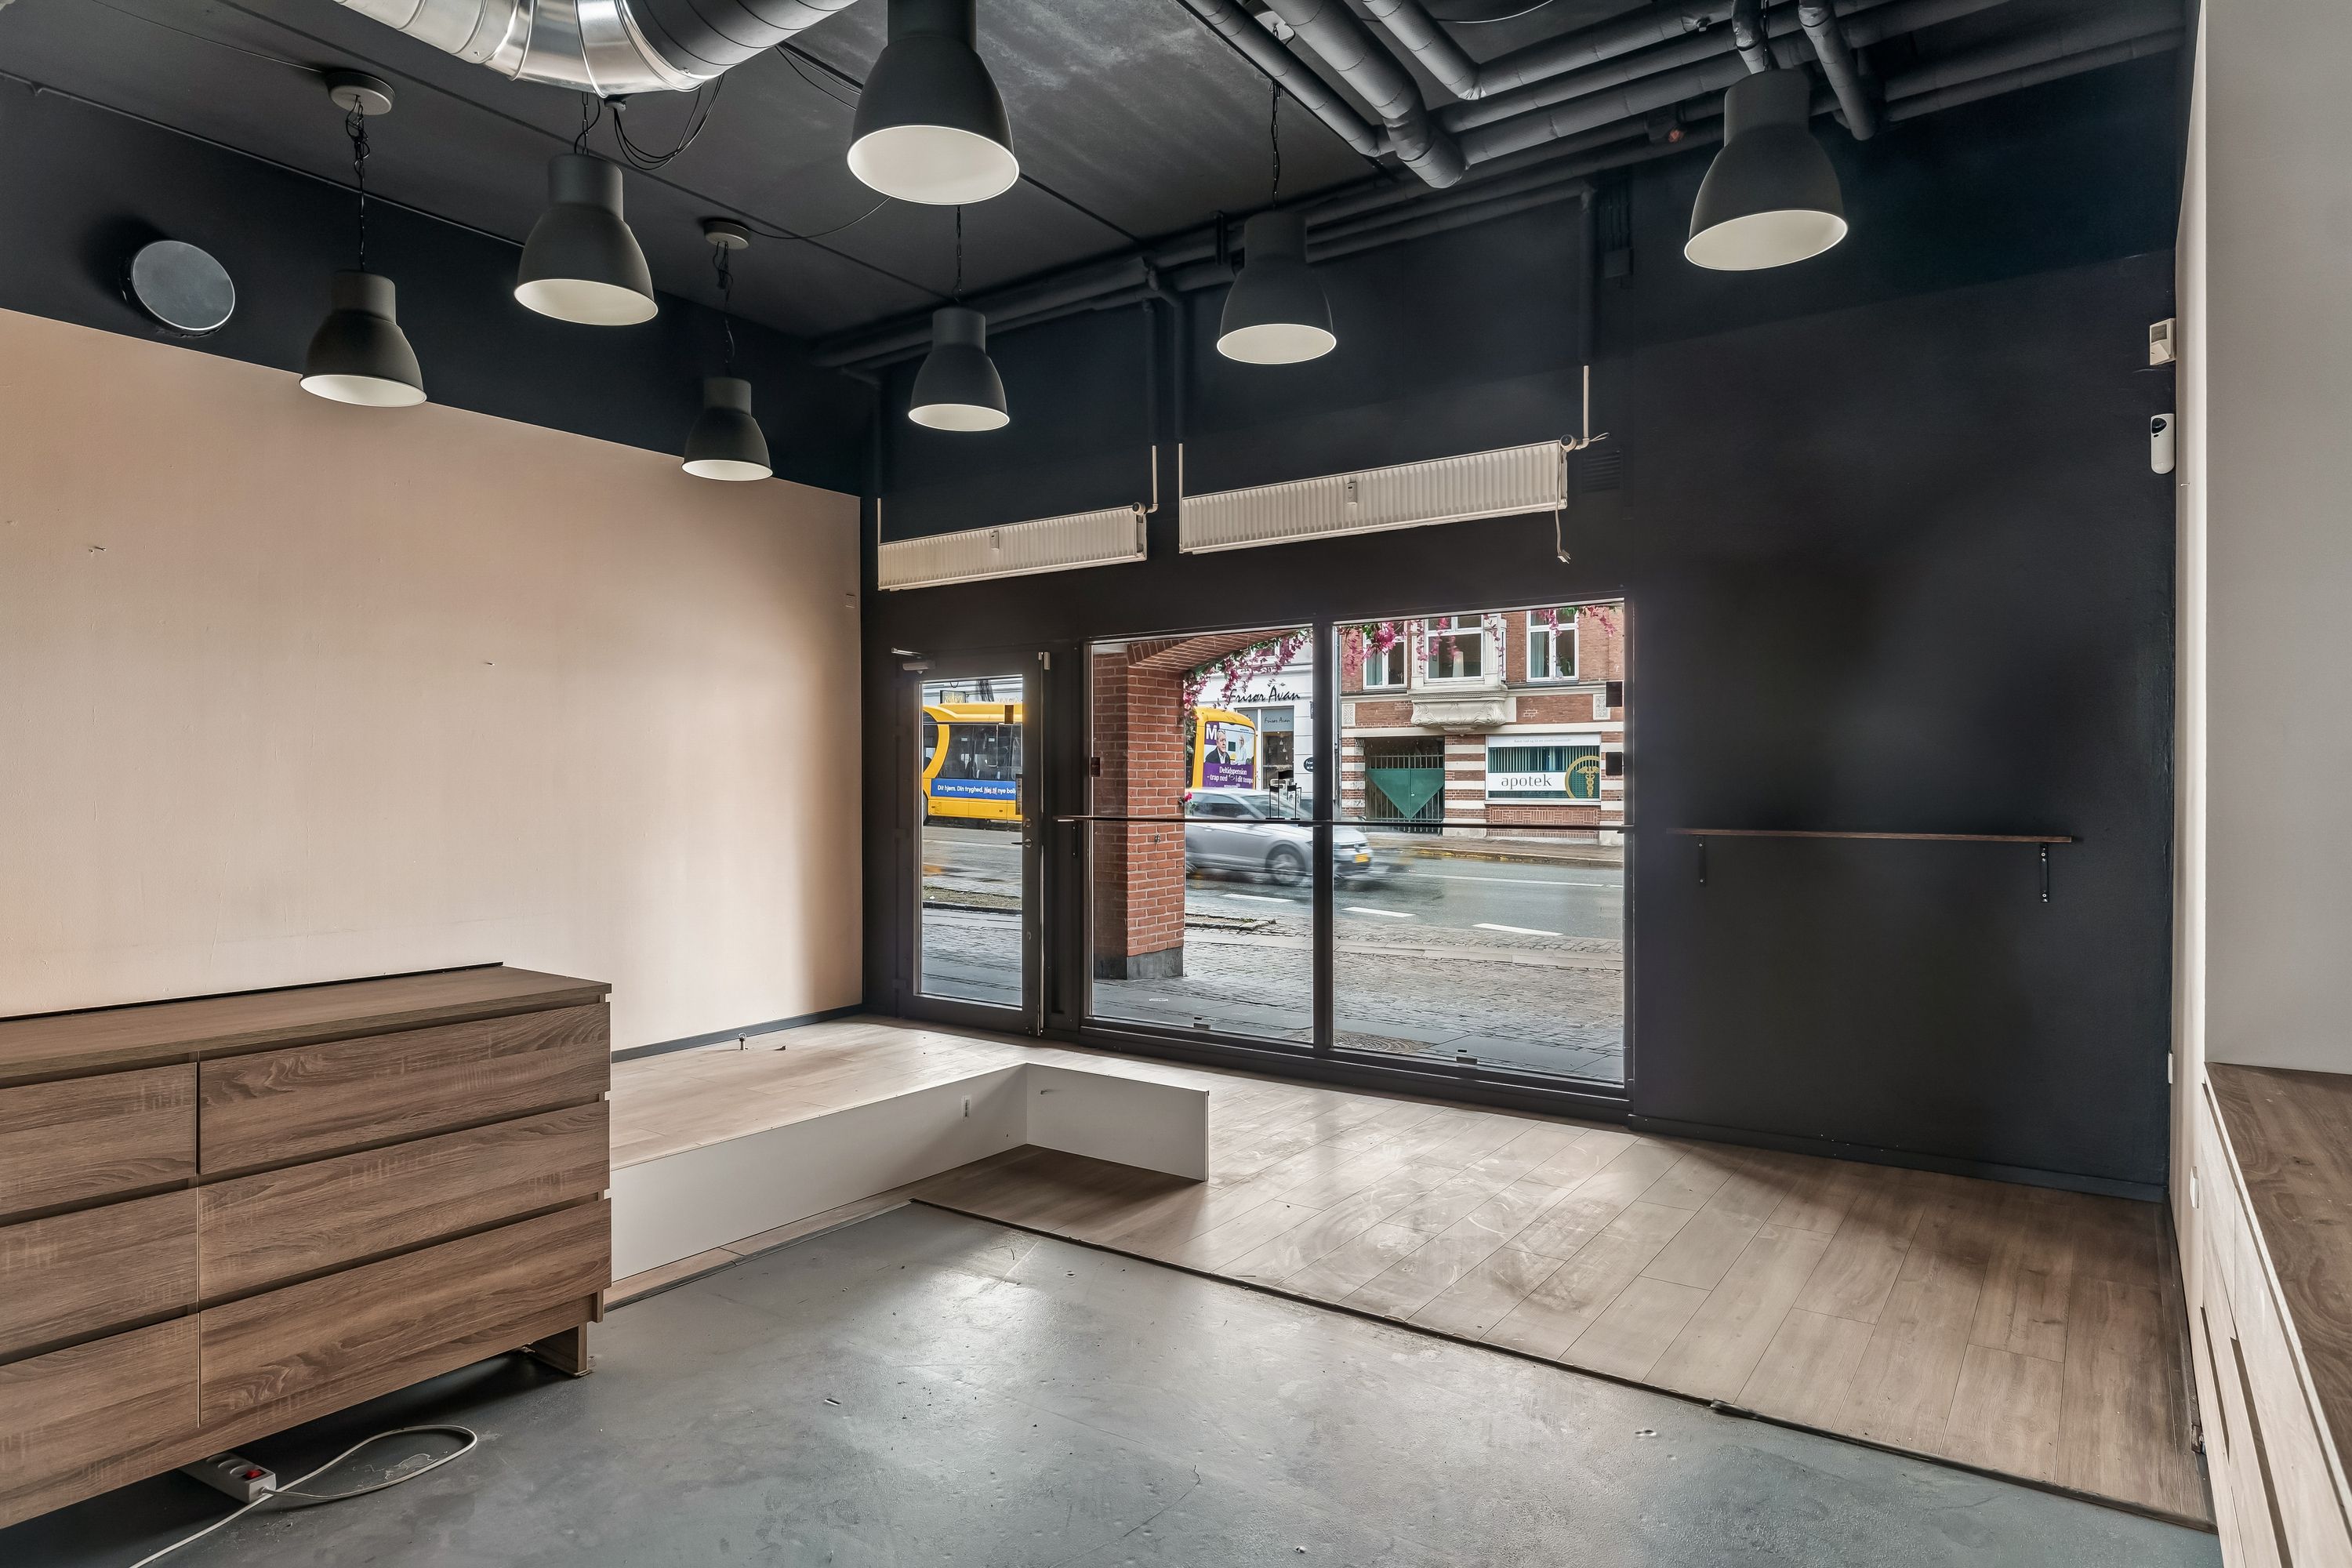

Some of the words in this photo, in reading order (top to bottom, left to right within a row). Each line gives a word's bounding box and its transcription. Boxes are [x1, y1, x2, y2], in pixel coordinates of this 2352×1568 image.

[1269, 685, 1300, 702] Avan
[1206, 724, 1218, 740] M
[1219, 766, 1247, 775] Deltidspension
[1501, 774, 1552, 789] apotek
